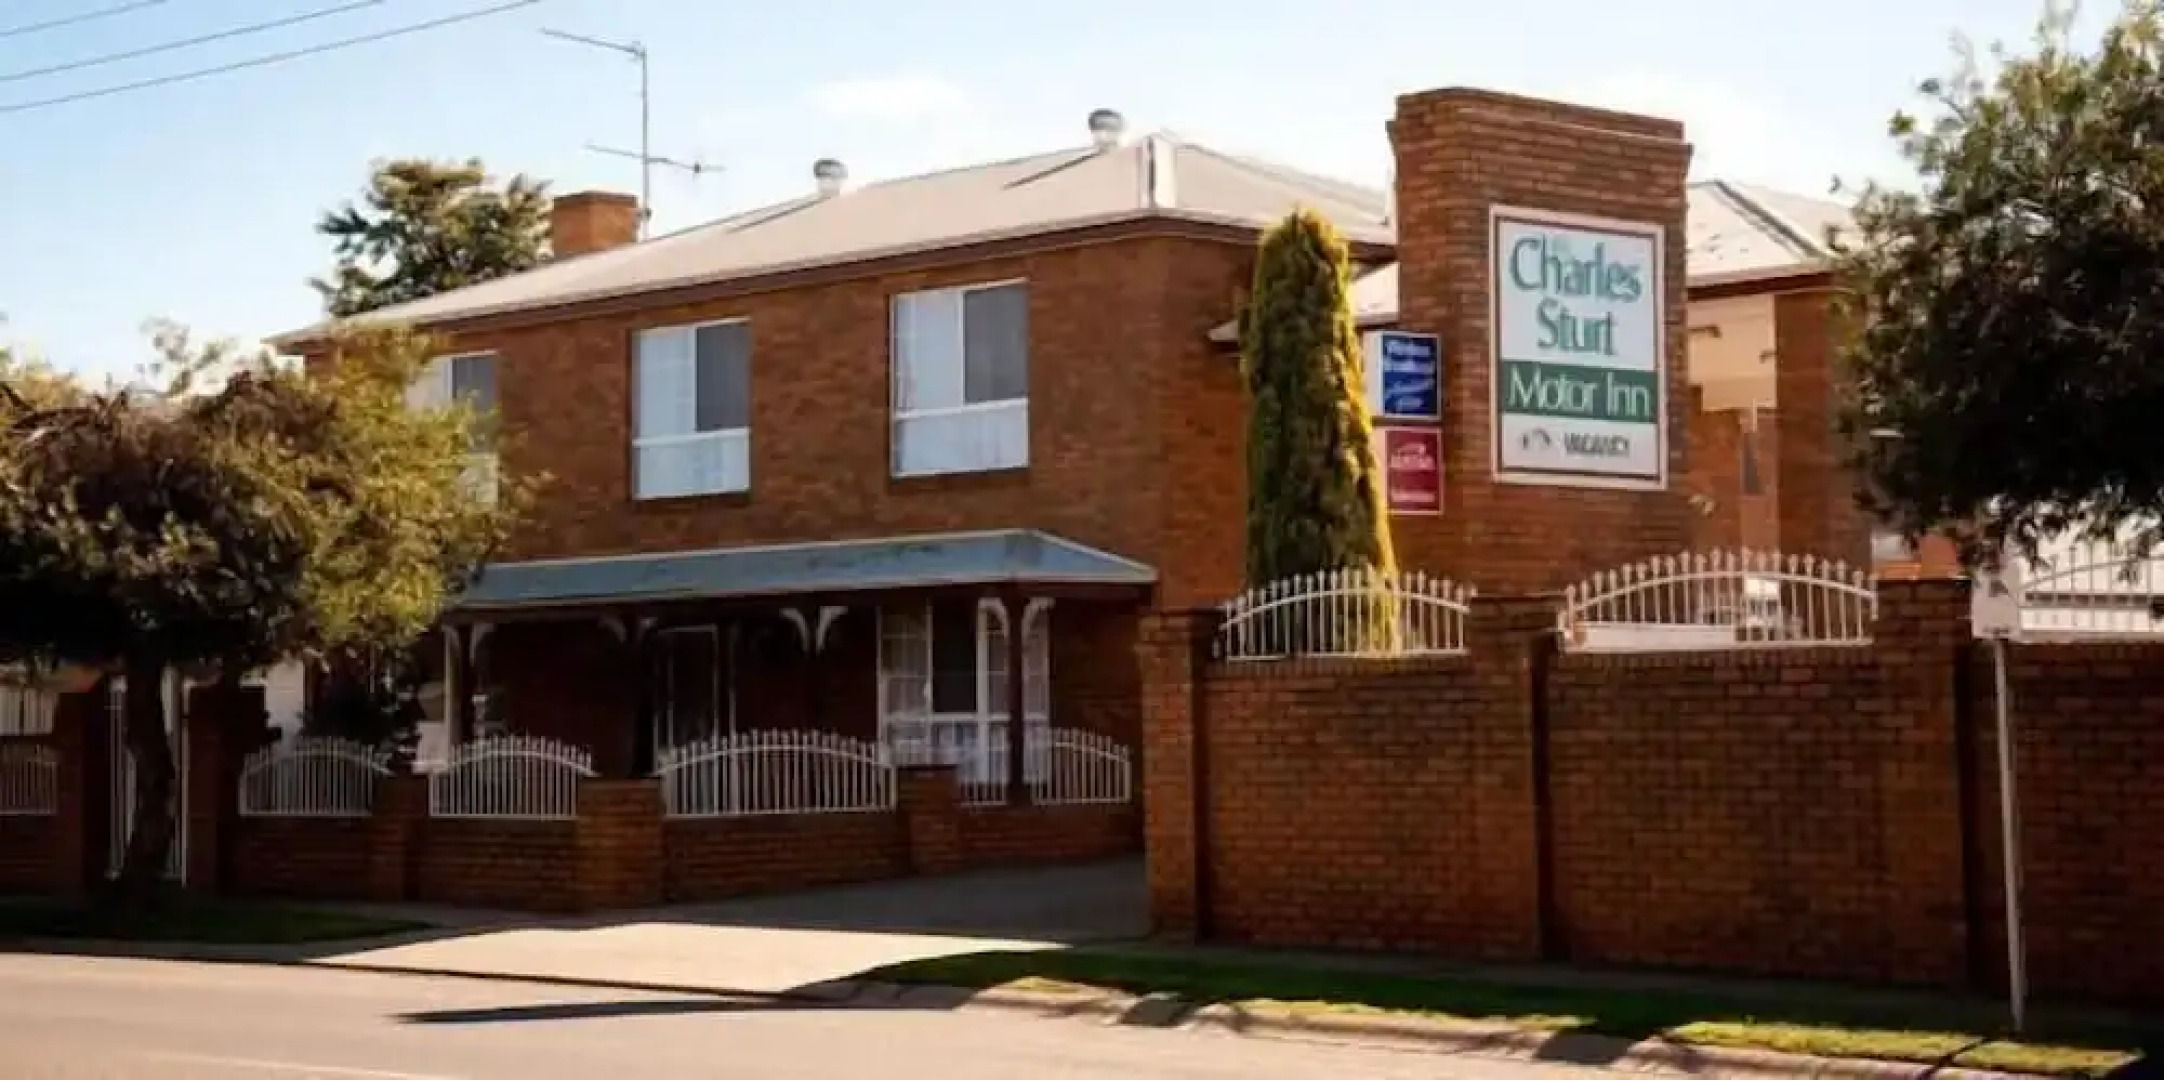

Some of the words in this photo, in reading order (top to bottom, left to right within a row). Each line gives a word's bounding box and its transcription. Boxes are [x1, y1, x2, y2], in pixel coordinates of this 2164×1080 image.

[1509, 235, 1642, 303] Charles
[1536, 296, 1617, 356] Sturt
[1509, 365, 1597, 413] Motor
[1606, 370, 1651, 418] Inn
